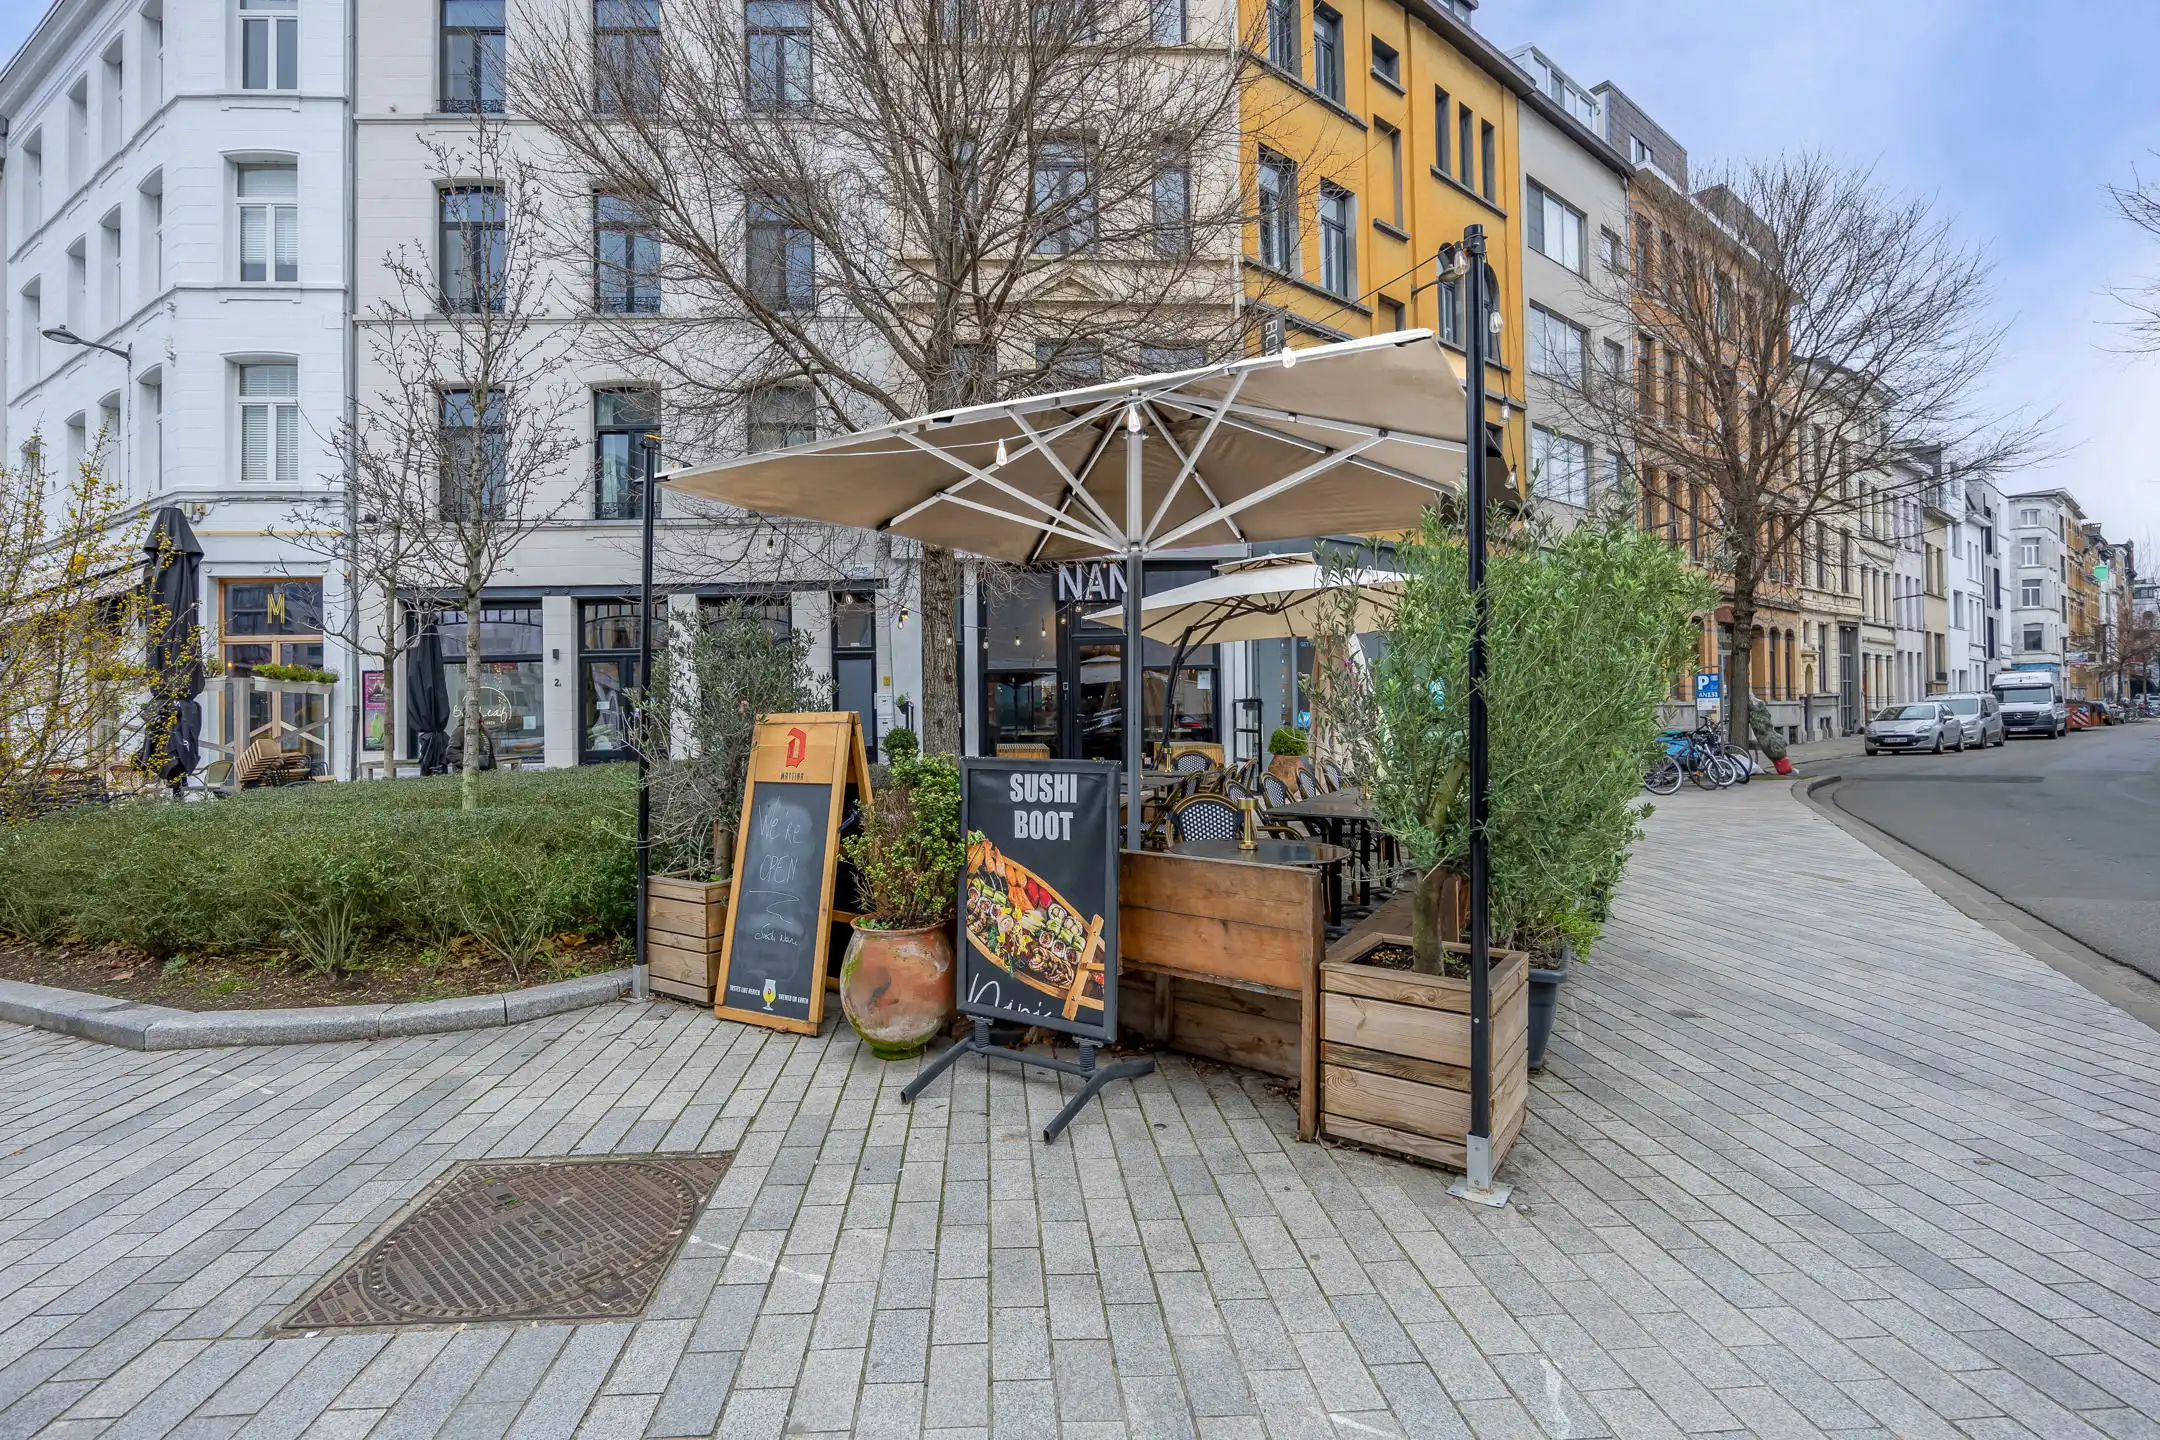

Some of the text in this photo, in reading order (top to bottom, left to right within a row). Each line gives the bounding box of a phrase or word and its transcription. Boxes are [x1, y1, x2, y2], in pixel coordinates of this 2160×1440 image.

[267, 593, 285, 624] M
[1697, 675, 1710, 690] P
[1009, 773, 1078, 803] SUSHI
[1014, 810, 1074, 841] BOOT
[760, 854, 799, 883] OPEN
